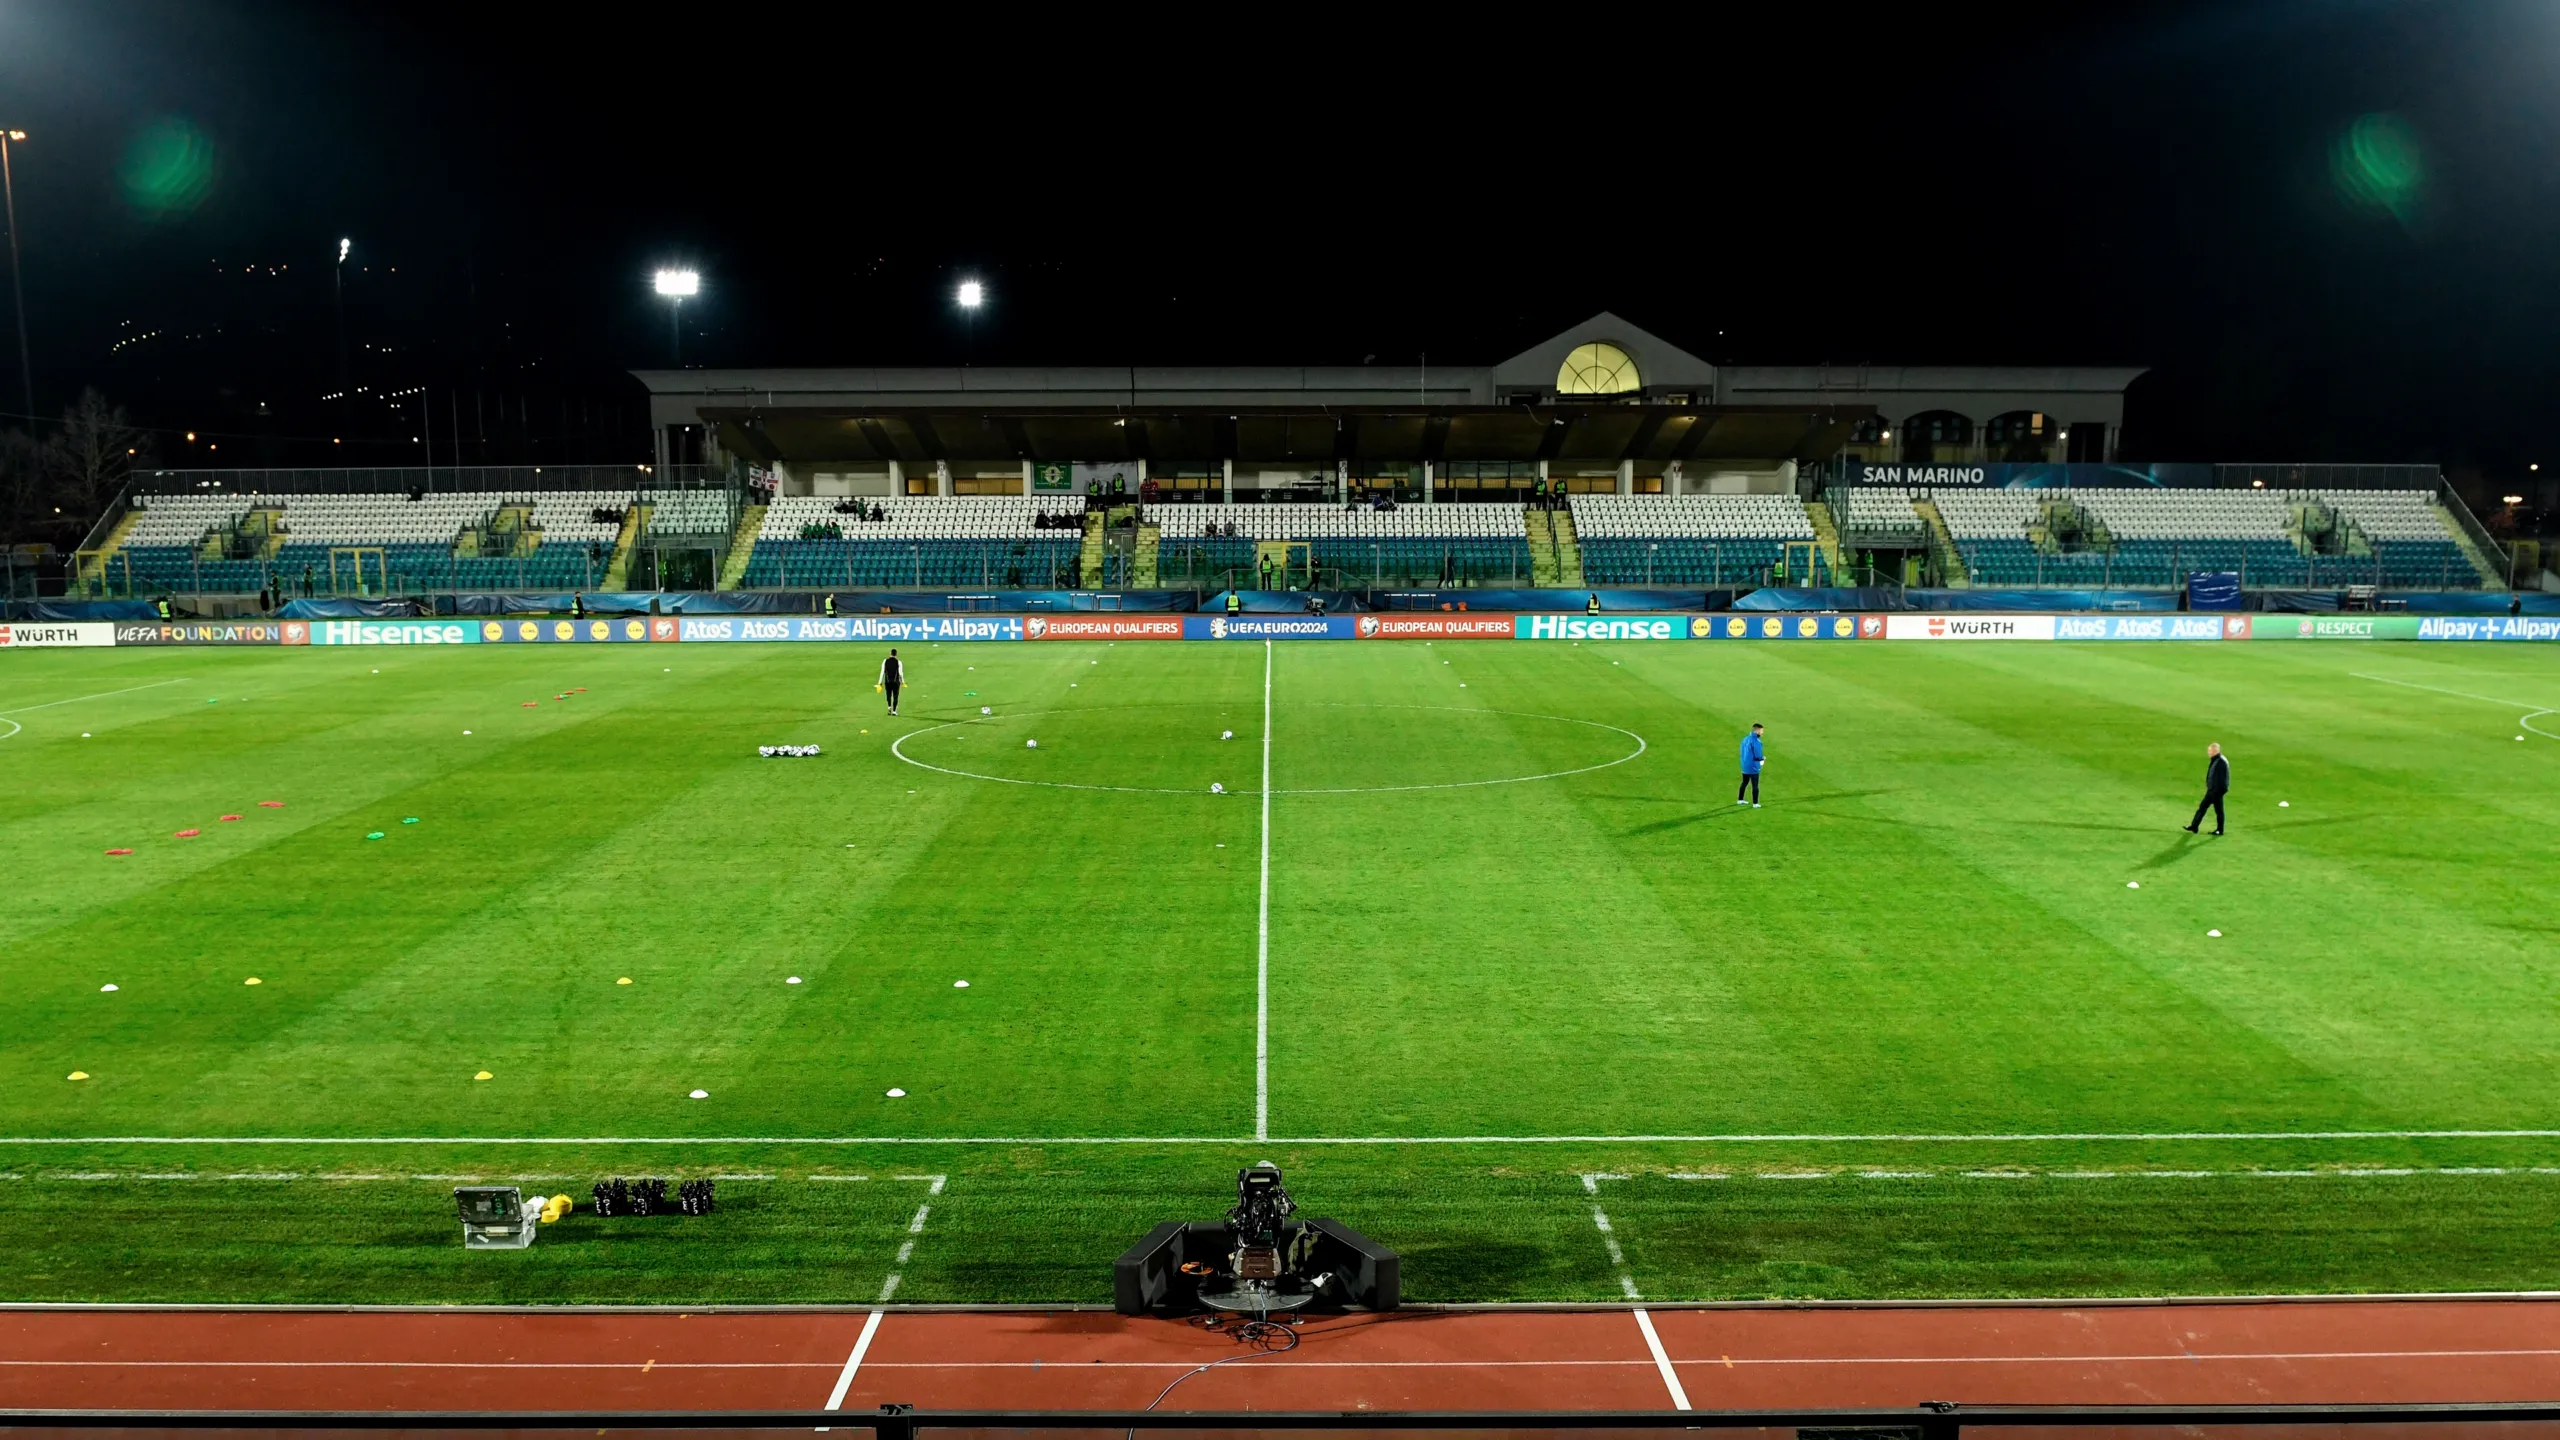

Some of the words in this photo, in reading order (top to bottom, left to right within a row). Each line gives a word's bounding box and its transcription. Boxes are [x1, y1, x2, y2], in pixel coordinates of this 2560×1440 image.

[1863, 467, 1900, 483] SAN
[1907, 467, 1984, 483] MARINO
[117, 626, 158, 641] UEFA
[326, 620, 464, 644] Hisense
[1050, 623, 1110, 634] EUROPEAN
[1113, 623, 1178, 635] QUALIFIERS
[1382, 622, 1442, 633] EUROPEAN
[1446, 621, 1510, 634] QUALIFIERS
[1531, 616, 1670, 639] Hisense
[2317, 622, 2374, 634] RESPECT
